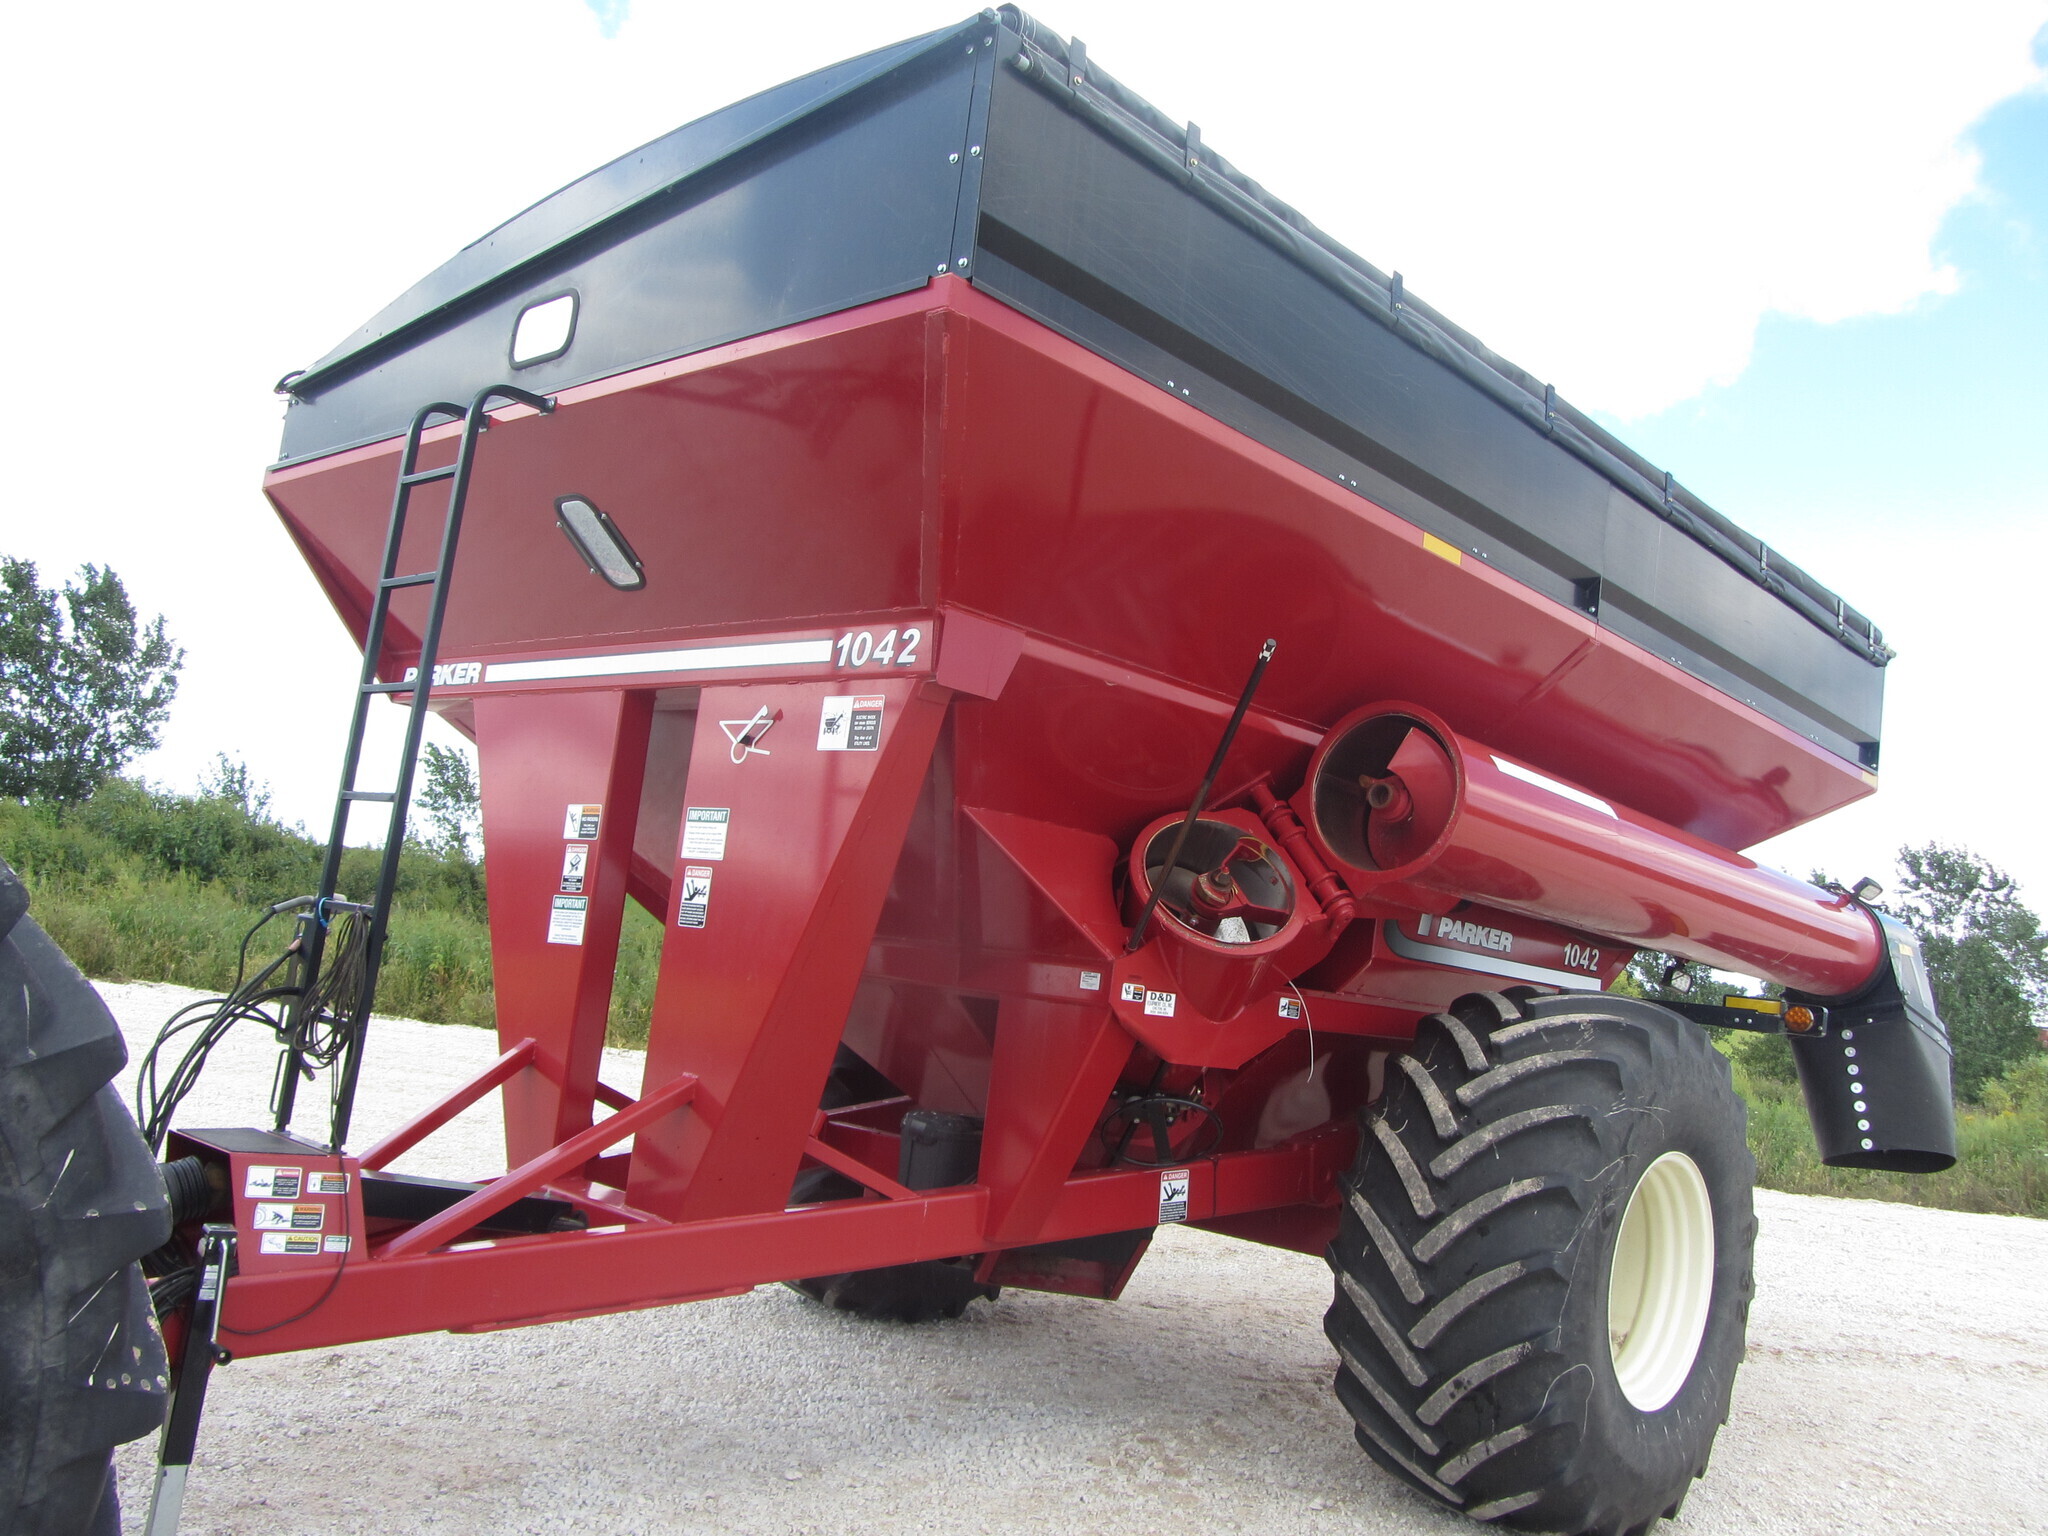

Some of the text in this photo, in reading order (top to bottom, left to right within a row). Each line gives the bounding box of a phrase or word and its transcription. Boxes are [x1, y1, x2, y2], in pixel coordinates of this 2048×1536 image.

[836, 627, 922, 669] 1042
[403, 662, 482, 686] PRKER
[860, 700, 883, 708] DANGER
[689, 809, 727, 821] IMPORTANT
[692, 869, 710, 877] DANGER
[555, 898, 586, 909] IMPORTANT
[1437, 916, 1514, 953] PARKER
[1563, 942, 1600, 972] 1042
[1150, 992, 1172, 1003] D&D
[1168, 1172, 1188, 1180] DANGER
